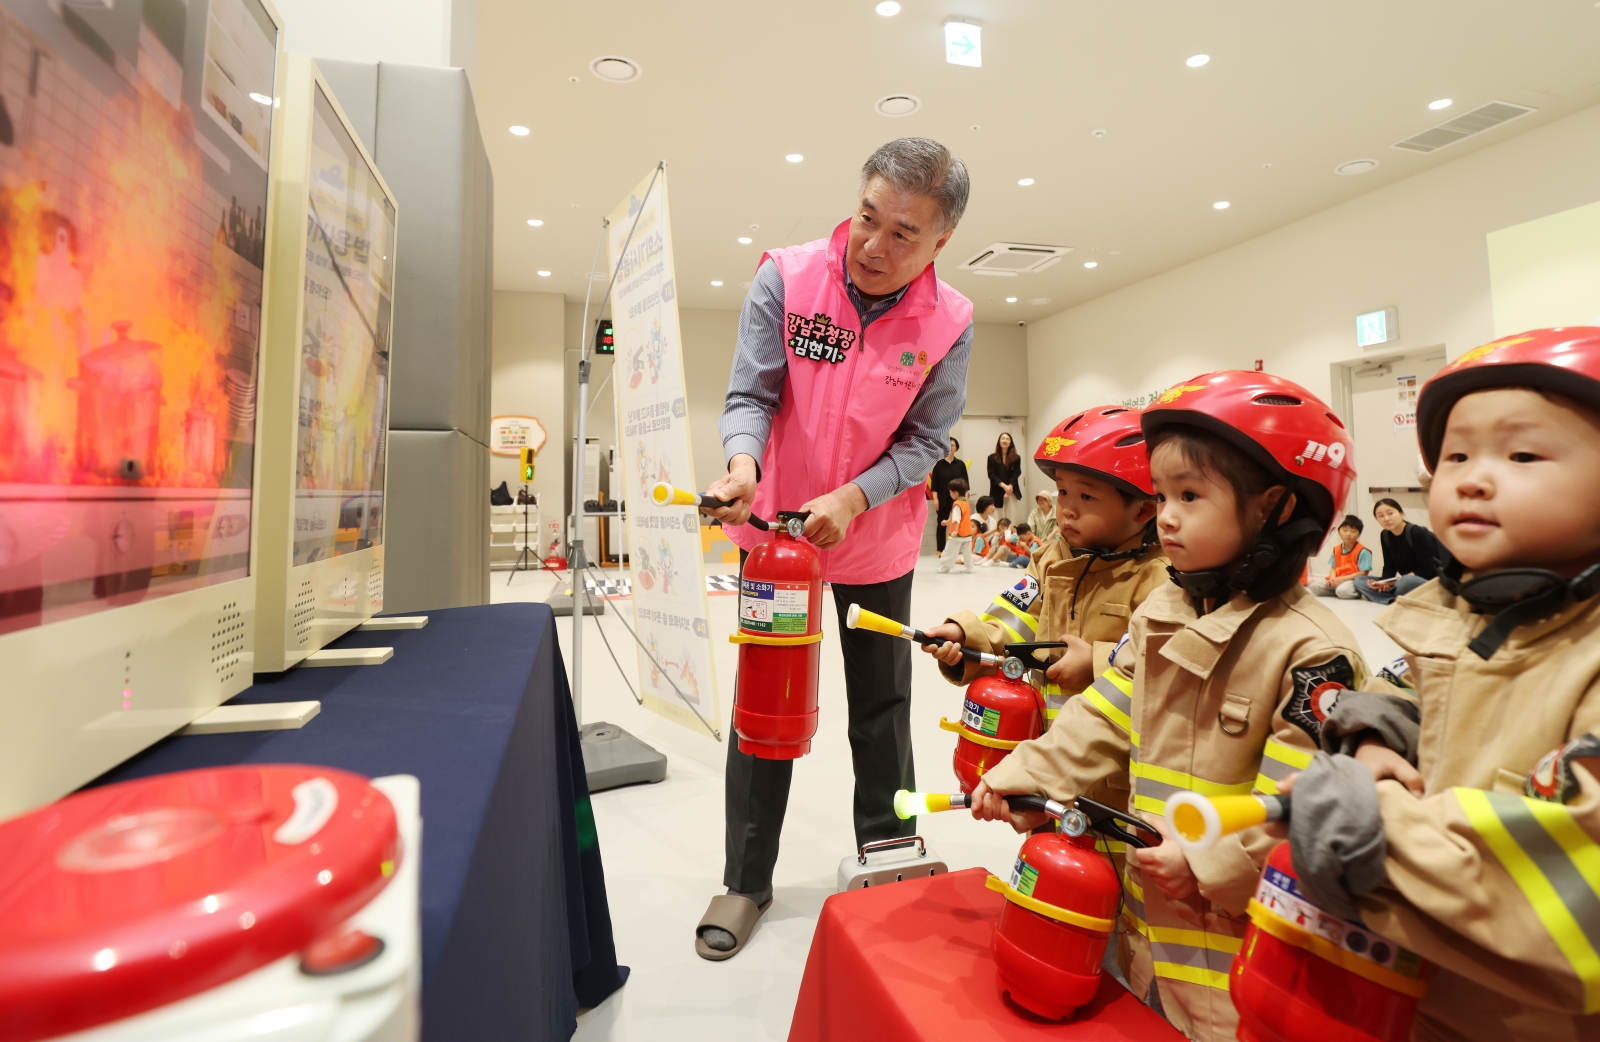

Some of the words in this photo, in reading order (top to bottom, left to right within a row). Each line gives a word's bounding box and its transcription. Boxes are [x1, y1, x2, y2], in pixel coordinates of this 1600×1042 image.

[788, 313, 855, 349] 강남구청장
[794, 336, 839, 363] 김현기
[1302, 440, 1346, 469] 119
[756, 584, 773, 592] 소화기
[1002, 590, 1024, 608] OREA
